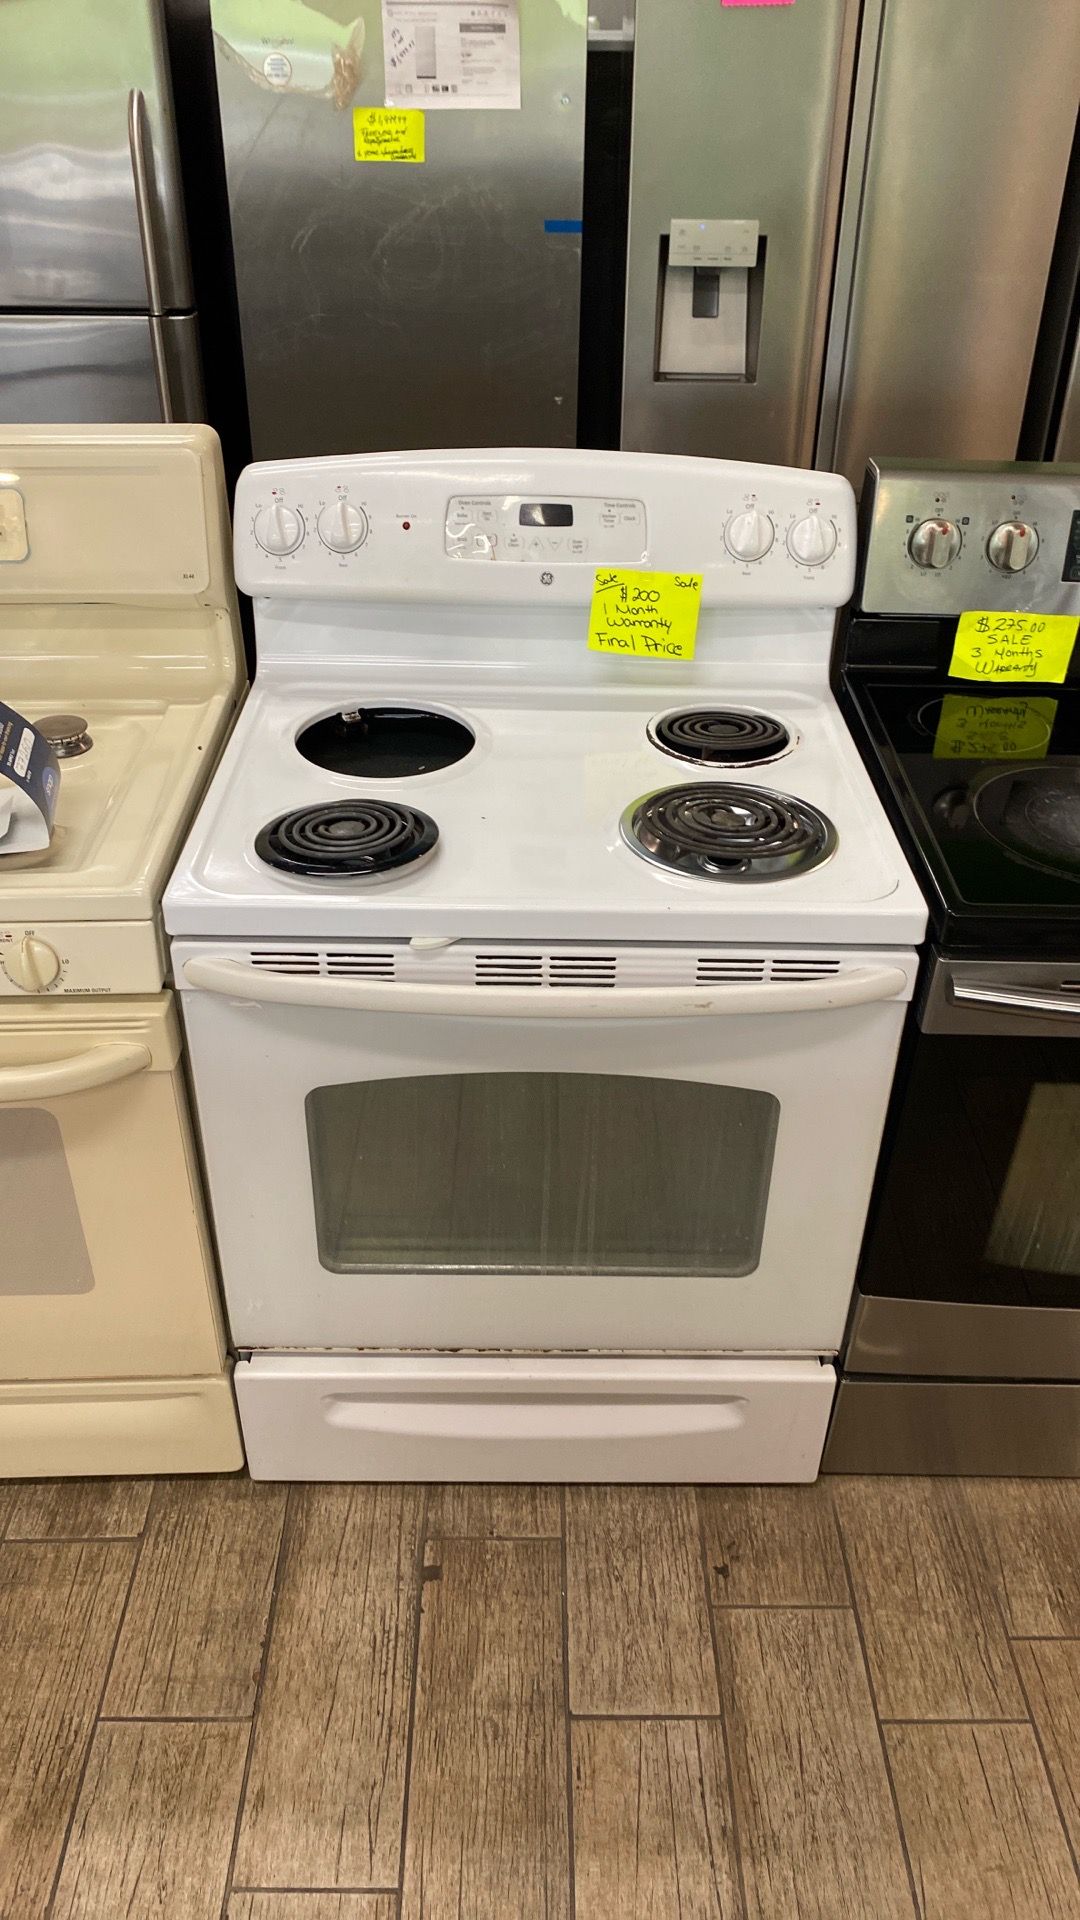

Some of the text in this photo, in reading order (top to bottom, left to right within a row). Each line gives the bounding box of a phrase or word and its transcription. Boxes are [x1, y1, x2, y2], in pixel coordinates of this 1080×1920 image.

[596, 574, 618, 586] Sale
[674, 576, 698, 591] Sale
[615, 604, 658, 615] Month
[607, 617, 672, 635] Warranty
[595, 632, 683, 656] Final Price
[987, 634, 1033, 645] SALE
[971, 647, 982, 658] 3
